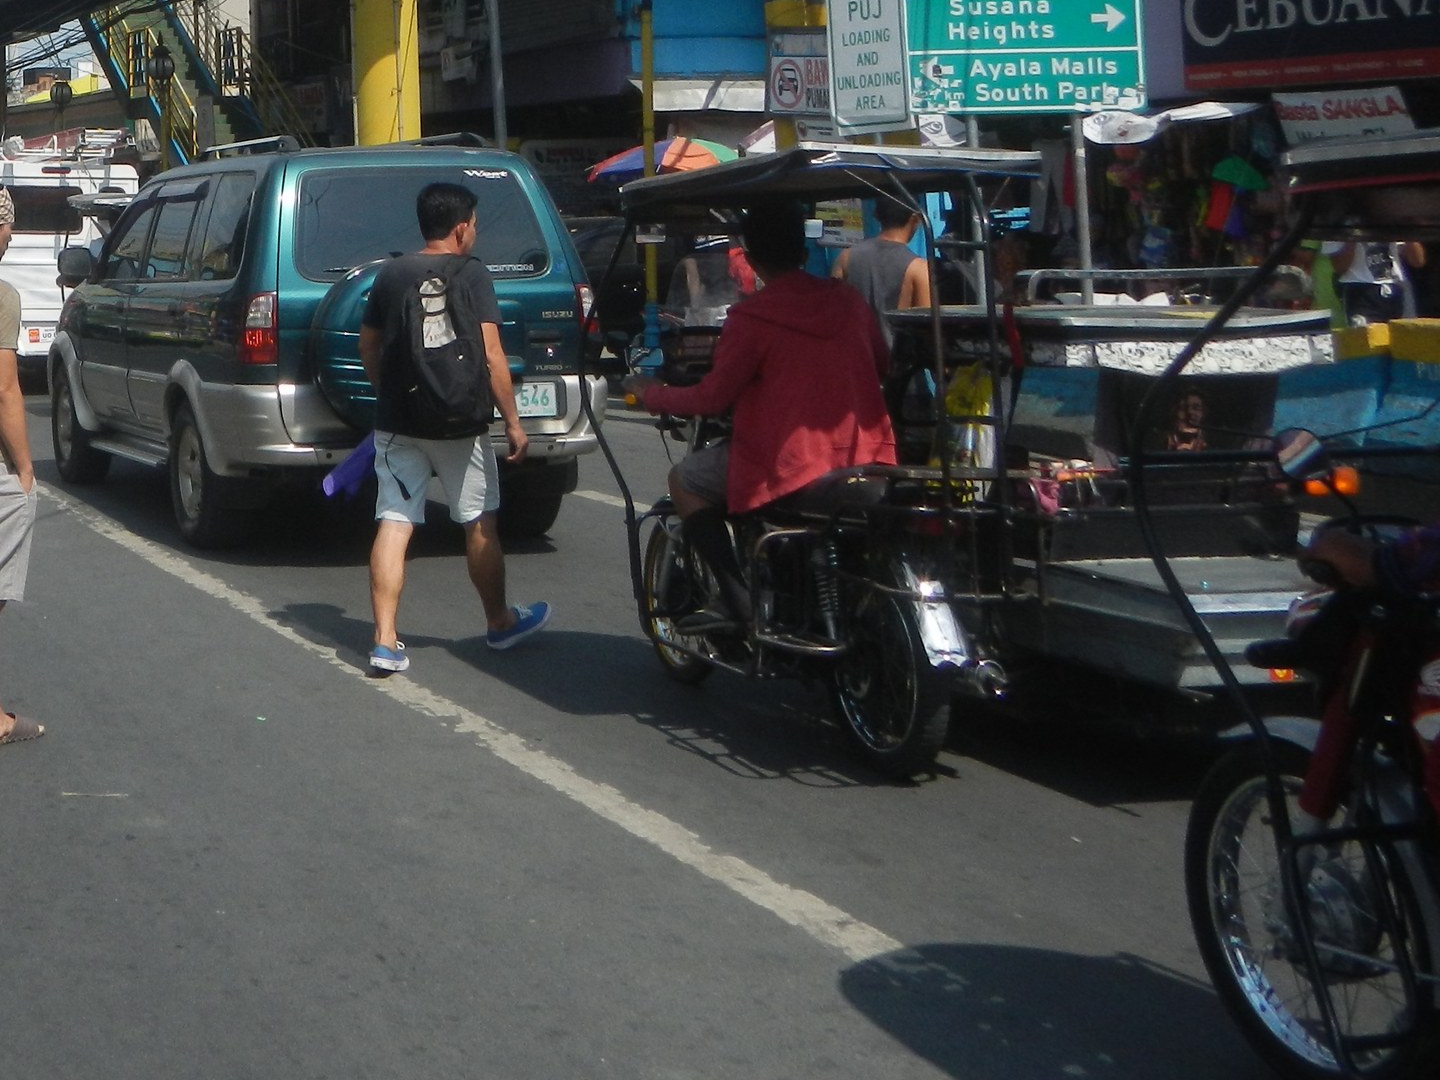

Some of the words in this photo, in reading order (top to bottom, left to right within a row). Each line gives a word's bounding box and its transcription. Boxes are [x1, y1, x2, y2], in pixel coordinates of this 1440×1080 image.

[841, 28, 891, 47] LOADING
[948, 21, 1055, 45] Heights
[856, 50, 879, 67] AND
[969, 58, 1041, 82] Ayala
[1051, 55, 1118, 77] Malls
[836, 71, 902, 91] UNLOADING
[975, 82, 1039, 102] South
[854, 95, 886, 111] AREA
[541, 310, 574, 318] ISUZU
